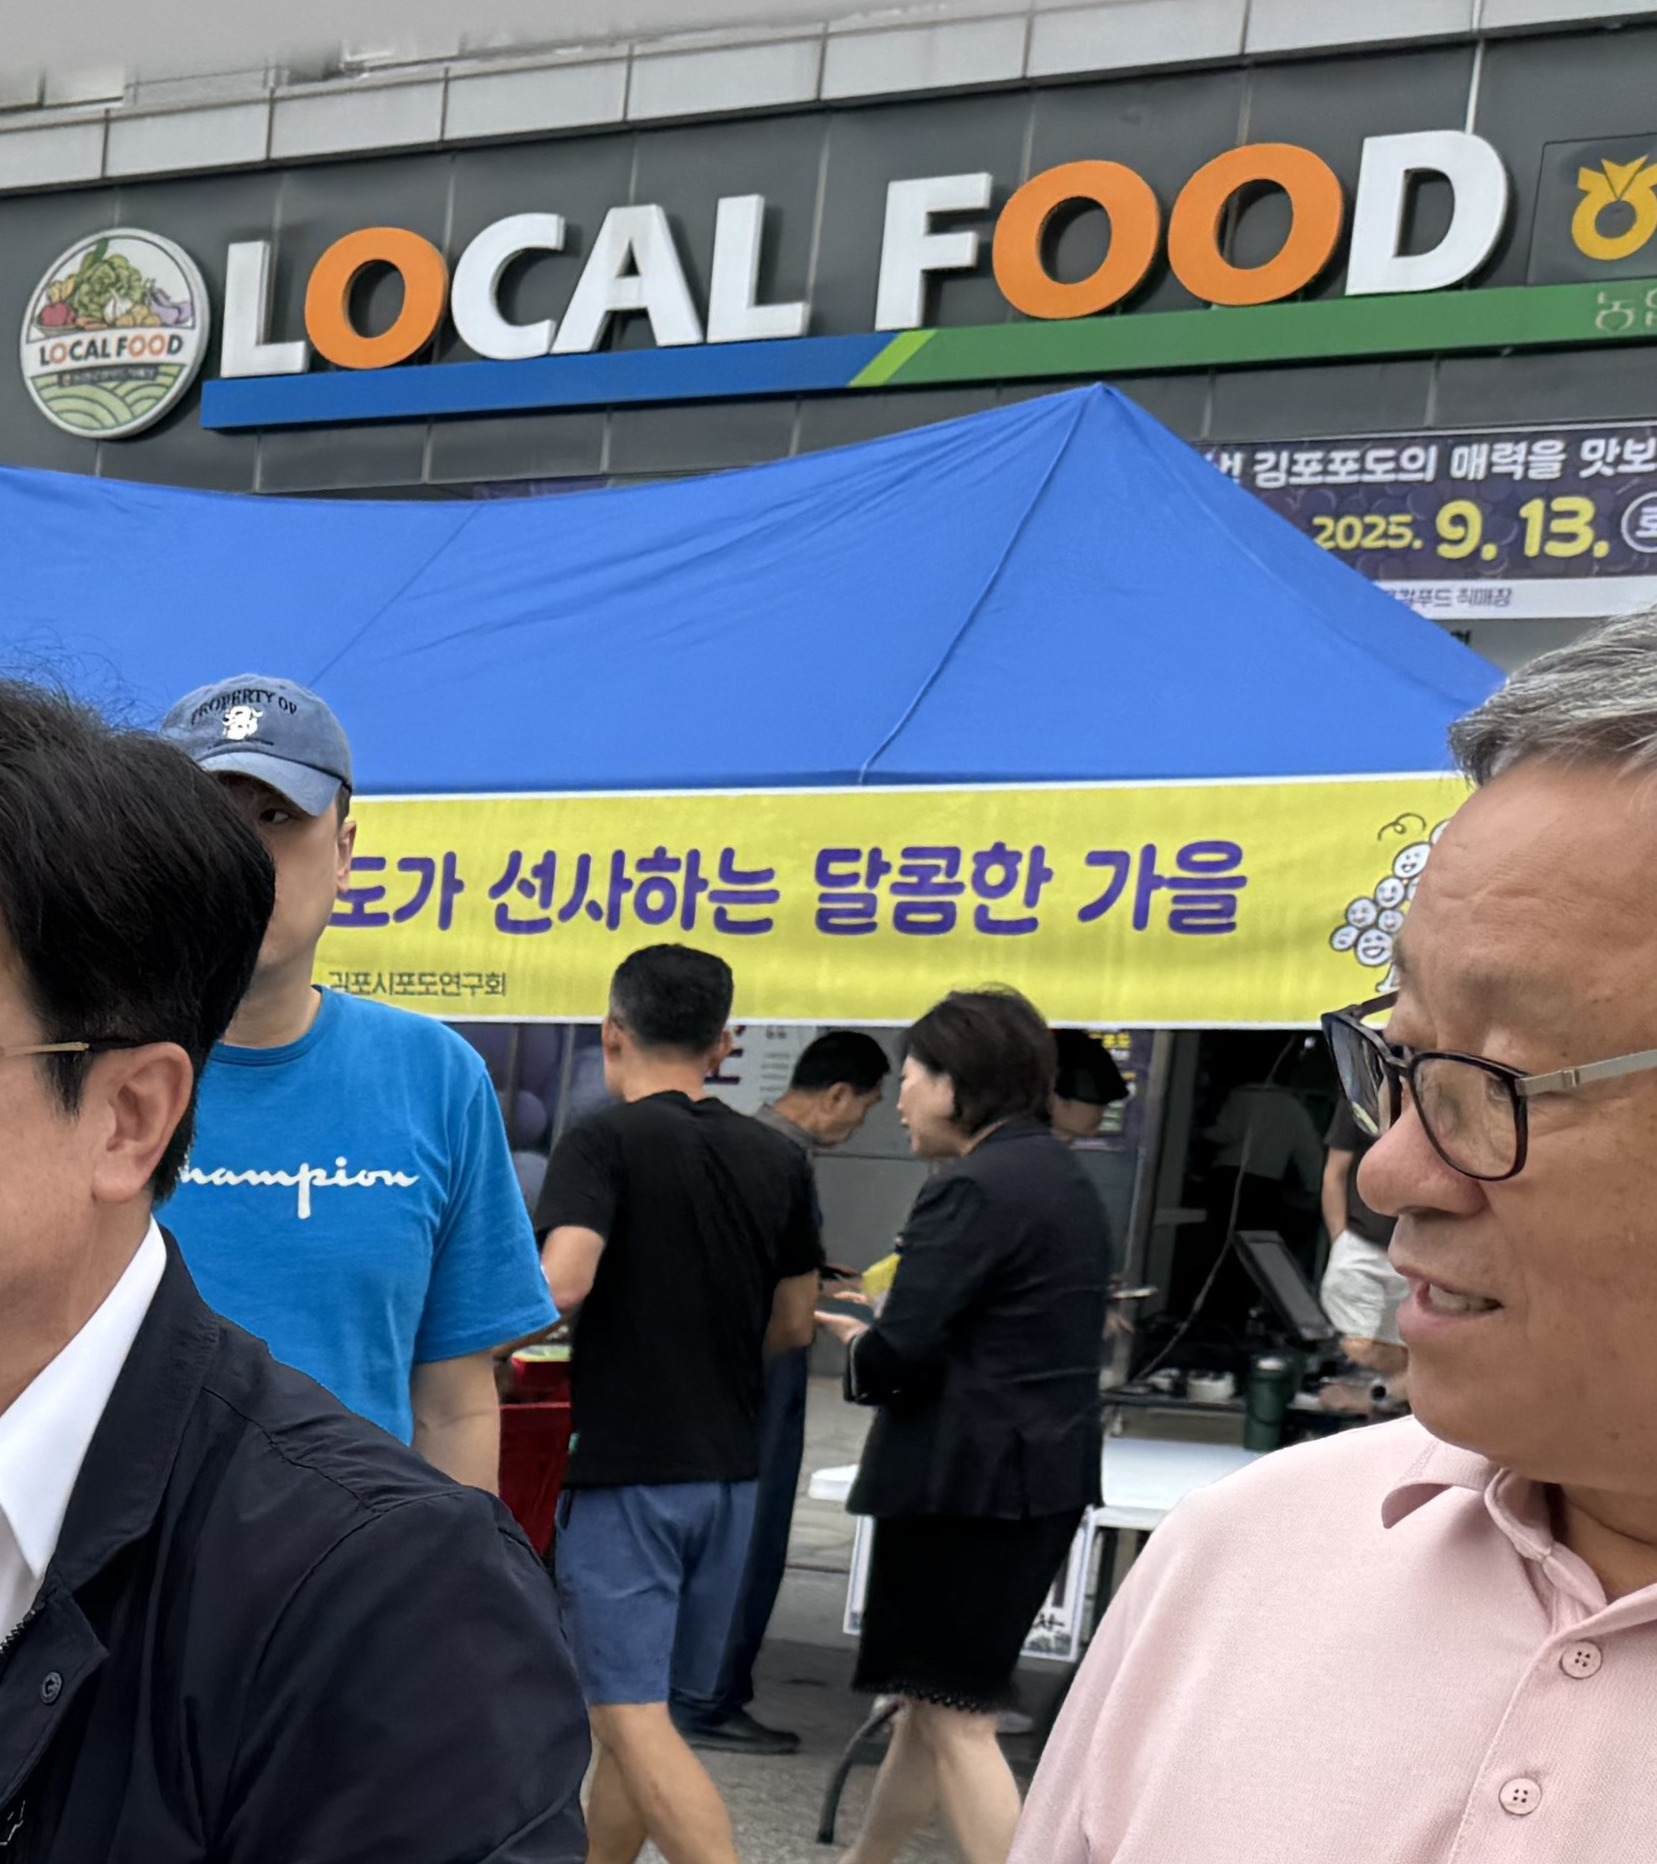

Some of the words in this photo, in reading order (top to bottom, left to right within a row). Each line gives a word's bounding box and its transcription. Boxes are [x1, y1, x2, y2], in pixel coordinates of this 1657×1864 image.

[220, 193, 809, 379] LOCAL
[875, 128, 1509, 331] FOOD
[38, 337, 111, 367] LOCAL
[115, 334, 184, 358] FOOD
[1253, 446, 1439, 489] 김포포도의
[1451, 440, 1566, 481] 매력을
[1313, 514, 1423, 551] 2025.
[1435, 499, 1499, 562] 9.
[1519, 495, 1611, 559] 13.
[327, 848, 465, 932] 도가
[487, 844, 782, 937] 선사하는
[813, 840, 1054, 937] 달콤한
[1076, 838, 1250, 936] 가을
[177, 1156, 421, 1220] hampion
